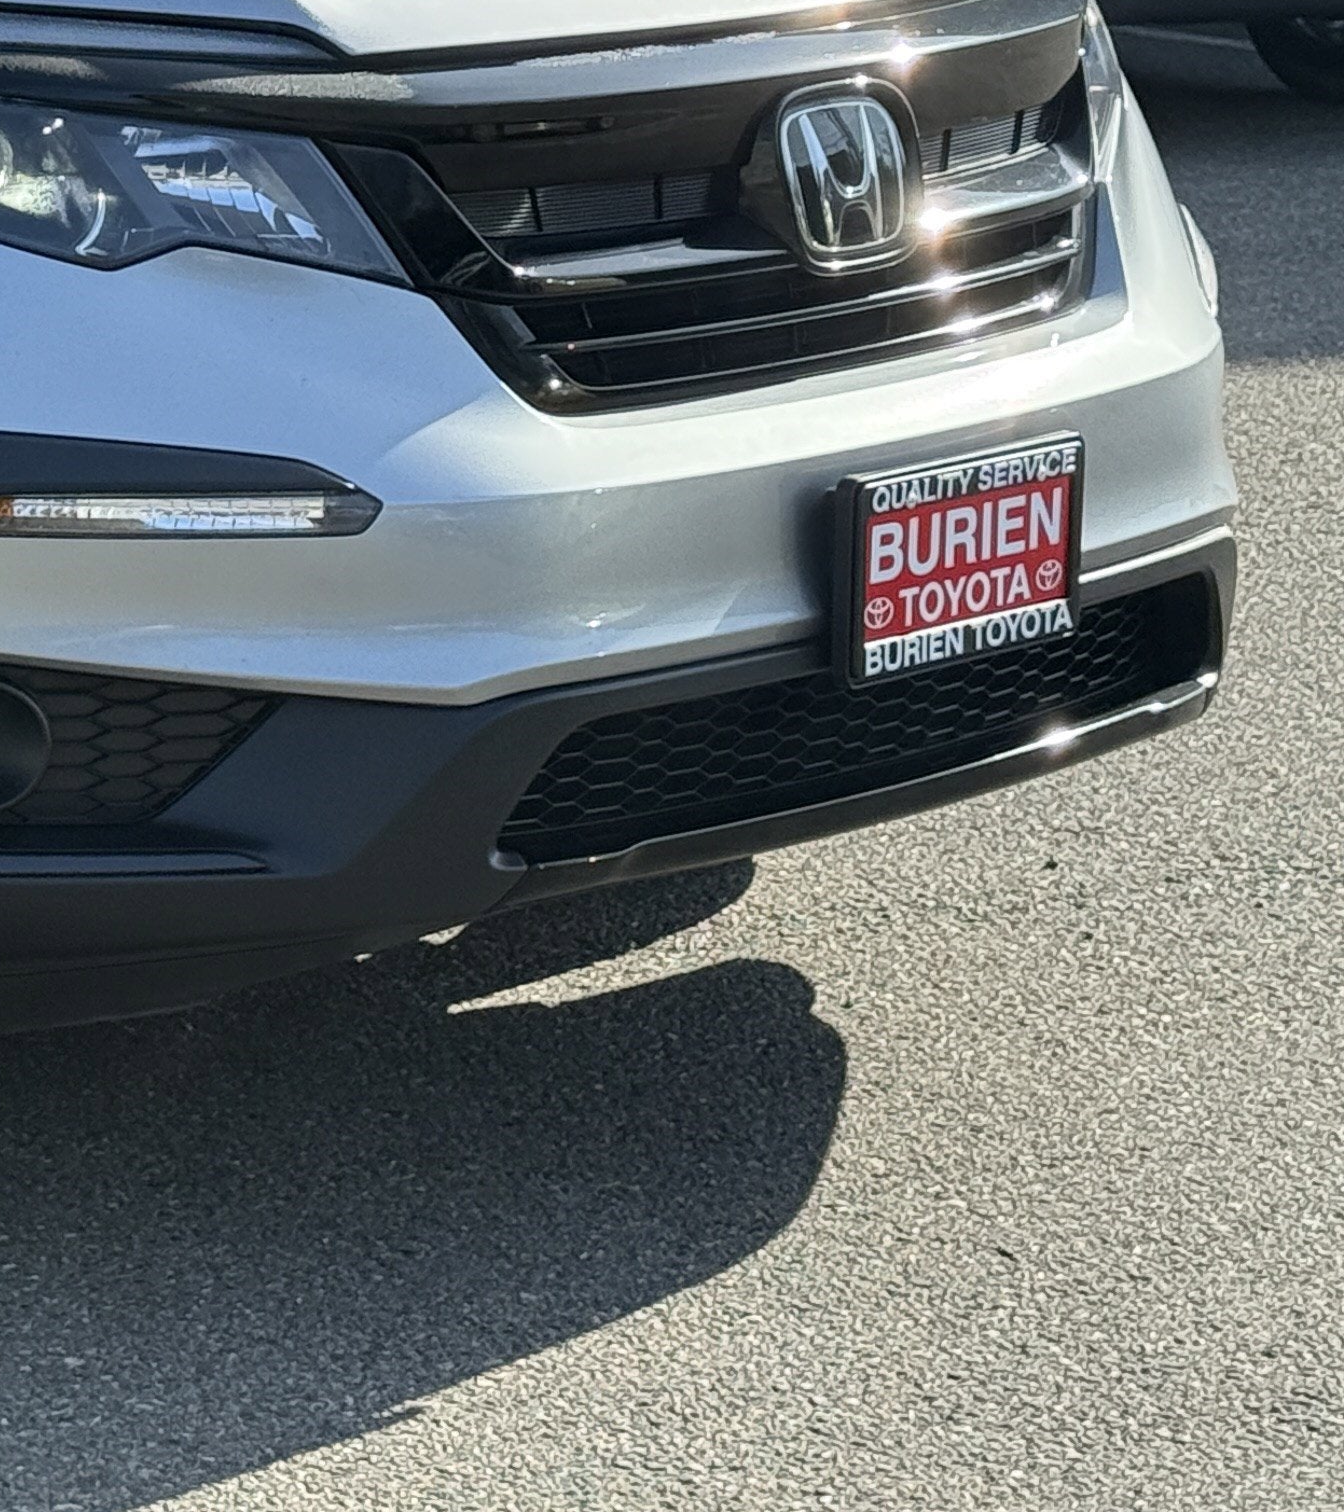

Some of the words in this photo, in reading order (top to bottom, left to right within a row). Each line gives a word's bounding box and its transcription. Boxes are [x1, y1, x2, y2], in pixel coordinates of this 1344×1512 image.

[872, 469, 976, 513] QUALITY
[978, 447, 1078, 491] SERVICE
[869, 486, 1063, 585] BURIEN
[898, 563, 1031, 627] TOYOTA
[864, 627, 962, 677] BURIEN
[972, 602, 1074, 651] TOYOTA
